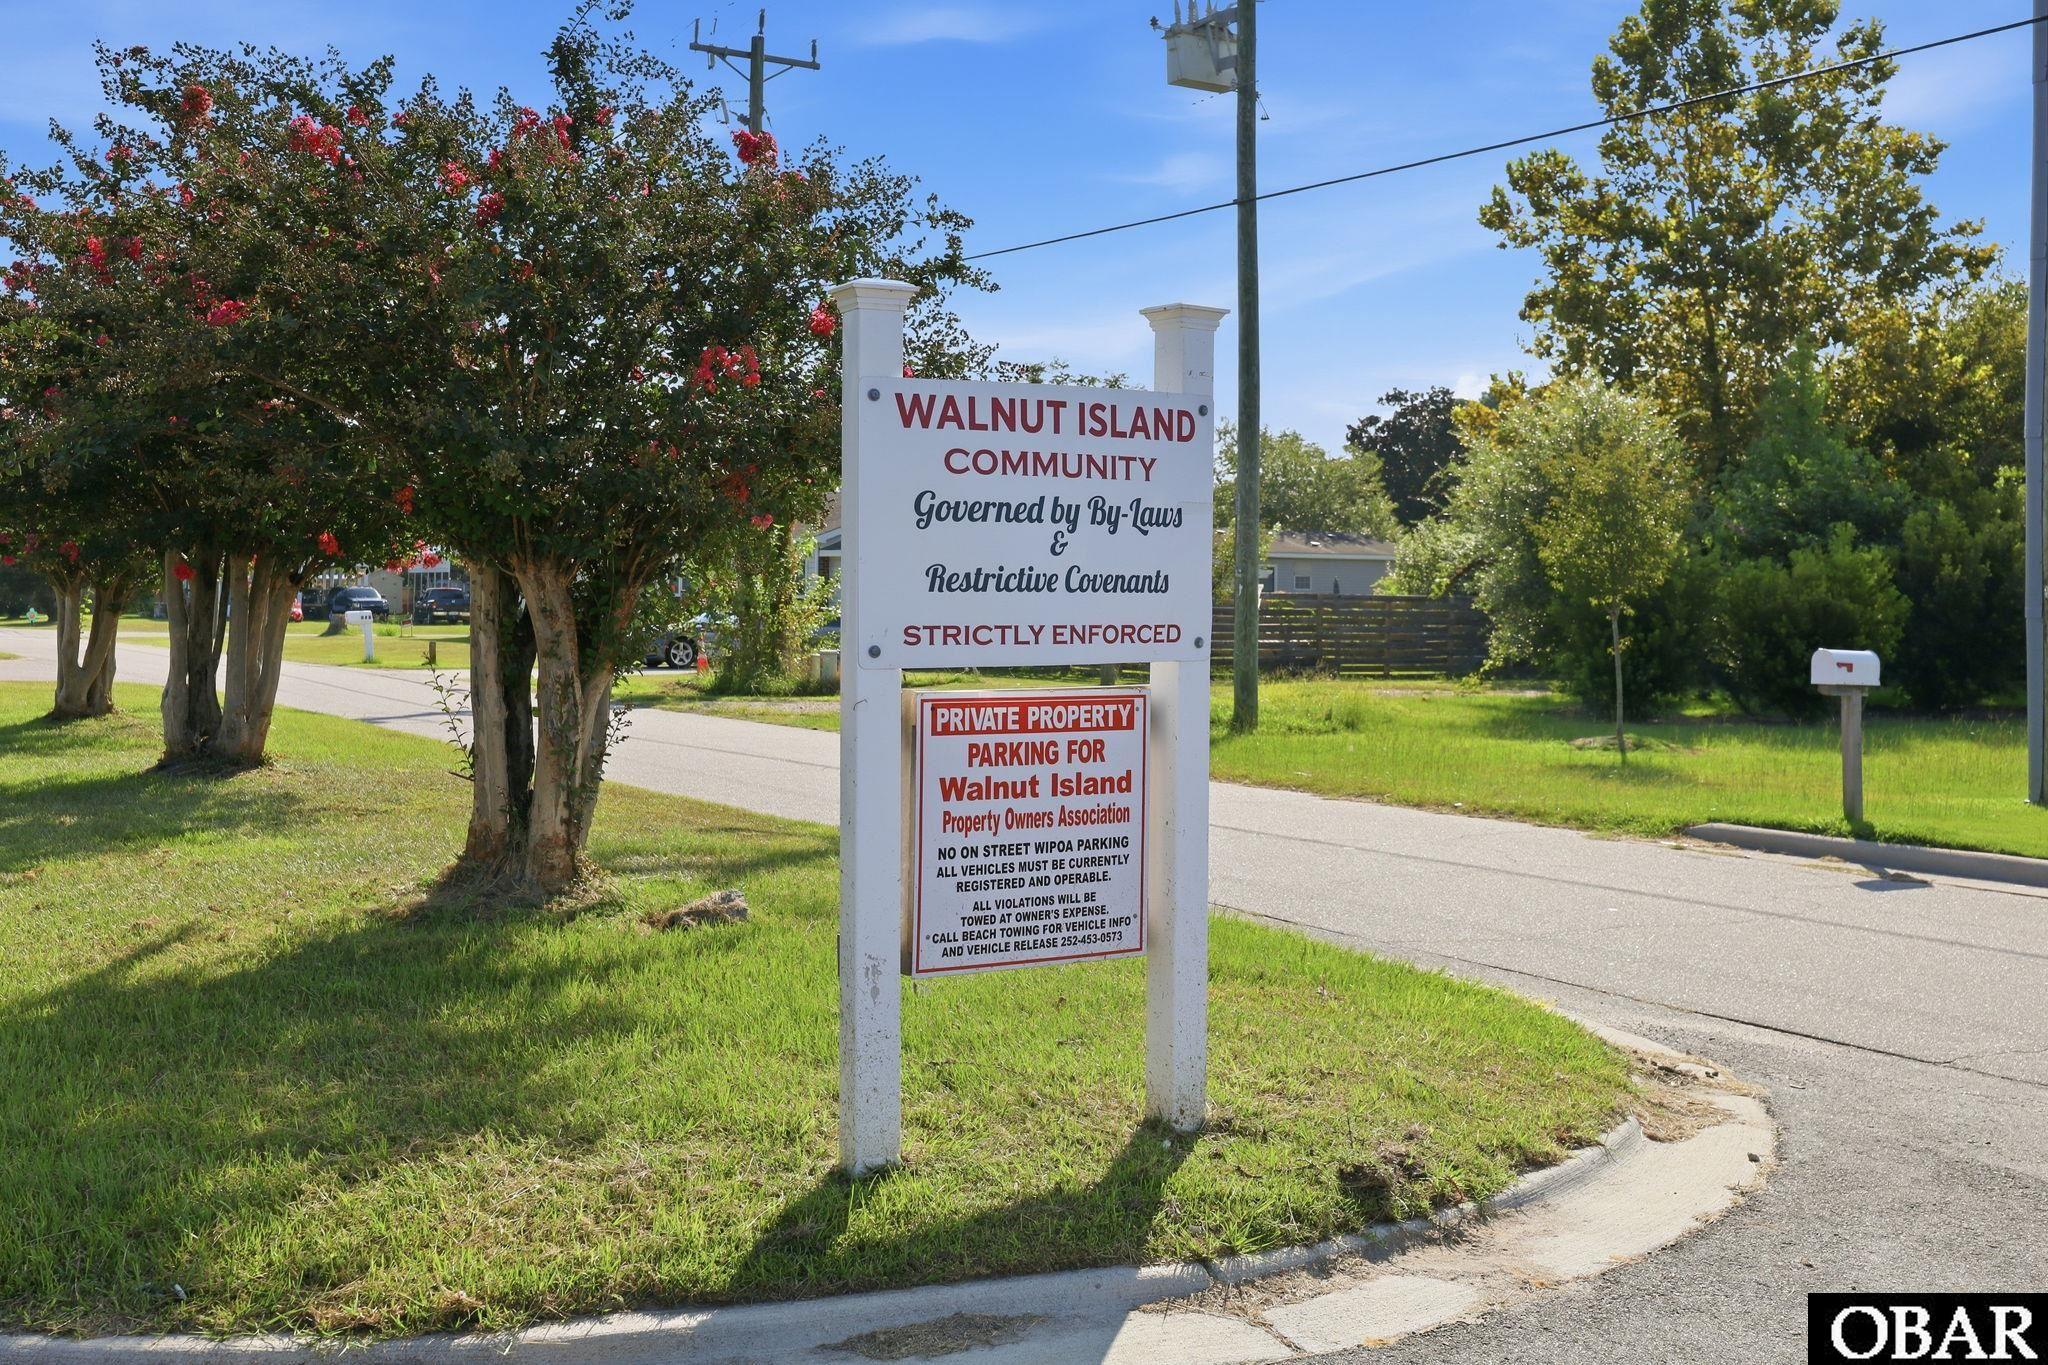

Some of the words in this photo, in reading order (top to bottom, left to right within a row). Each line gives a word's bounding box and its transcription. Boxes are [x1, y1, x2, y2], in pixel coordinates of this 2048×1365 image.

[894, 392, 1067, 435] WALNUT
[1079, 402, 1196, 443] ISLAND
[944, 448, 1157, 482] COMMUNITY
[914, 490, 1045, 530] Governed
[1050, 496, 1080, 534] by
[1087, 495, 1183, 536] By-Laws
[1050, 530, 1069, 557] &
[925, 563, 1059, 593] Restrictive
[1065, 564, 1170, 594] Covenants
[903, 625, 1045, 646] STRICTLY
[1052, 624, 1181, 645] ENFORCED
[936, 706, 1020, 732] PRIVATE
[1027, 703, 1132, 730] PROPERTY
[968, 740, 1059, 768] PARKING
[1067, 739, 1105, 764] FOR
[939, 774, 1040, 802] Walnut
[1051, 769, 1132, 797] Island
[942, 810, 1001, 838] Property
[1005, 807, 1054, 830] Owners
[1057, 802, 1130, 827] Association
[937, 847, 956, 860] NO
[960, 845, 979, 859] ON
[982, 843, 1030, 858] STREET
[1035, 839, 1073, 855] WIPOA
[1077, 836, 1129, 852] PARKING
[936, 866, 958, 878] ALL
[961, 862, 1015, 877] VEHICLES
[1018, 860, 1048, 873] MUST
[1052, 858, 1066, 870] BE
[1068, 854, 1130, 869] CURRENTLY
[956, 877, 1025, 892] REGISTERED
[1028, 875, 1051, 887] AND
[1054, 871, 1112, 886] OPERABLE.
[960, 914, 997, 927] TOWED
[999, 913, 1012, 924] AT
[1015, 909, 1060, 923] OWNER'S
[1063, 905, 1110, 920] EXPENSE.
[972, 900, 992, 912] ALL
[994, 895, 1055, 910] VIOLATIONS
[1057, 893, 1081, 905] WILL
[1084, 892, 1097, 903] BE
[932, 931, 959, 944] CALL
[962, 928, 997, 942] BEACH
[999, 924, 1039, 938] TOWING
[1043, 922, 1062, 934] FOR
[1065, 918, 1106, 932] VEHICLE
[1109, 916, 1131, 928] INFO
[941, 946, 964, 958] AND
[966, 941, 1011, 956] VEHICLE
[1013, 937, 1058, 951] RELEASE
[1061, 931, 1123, 947] 252-453-0573
